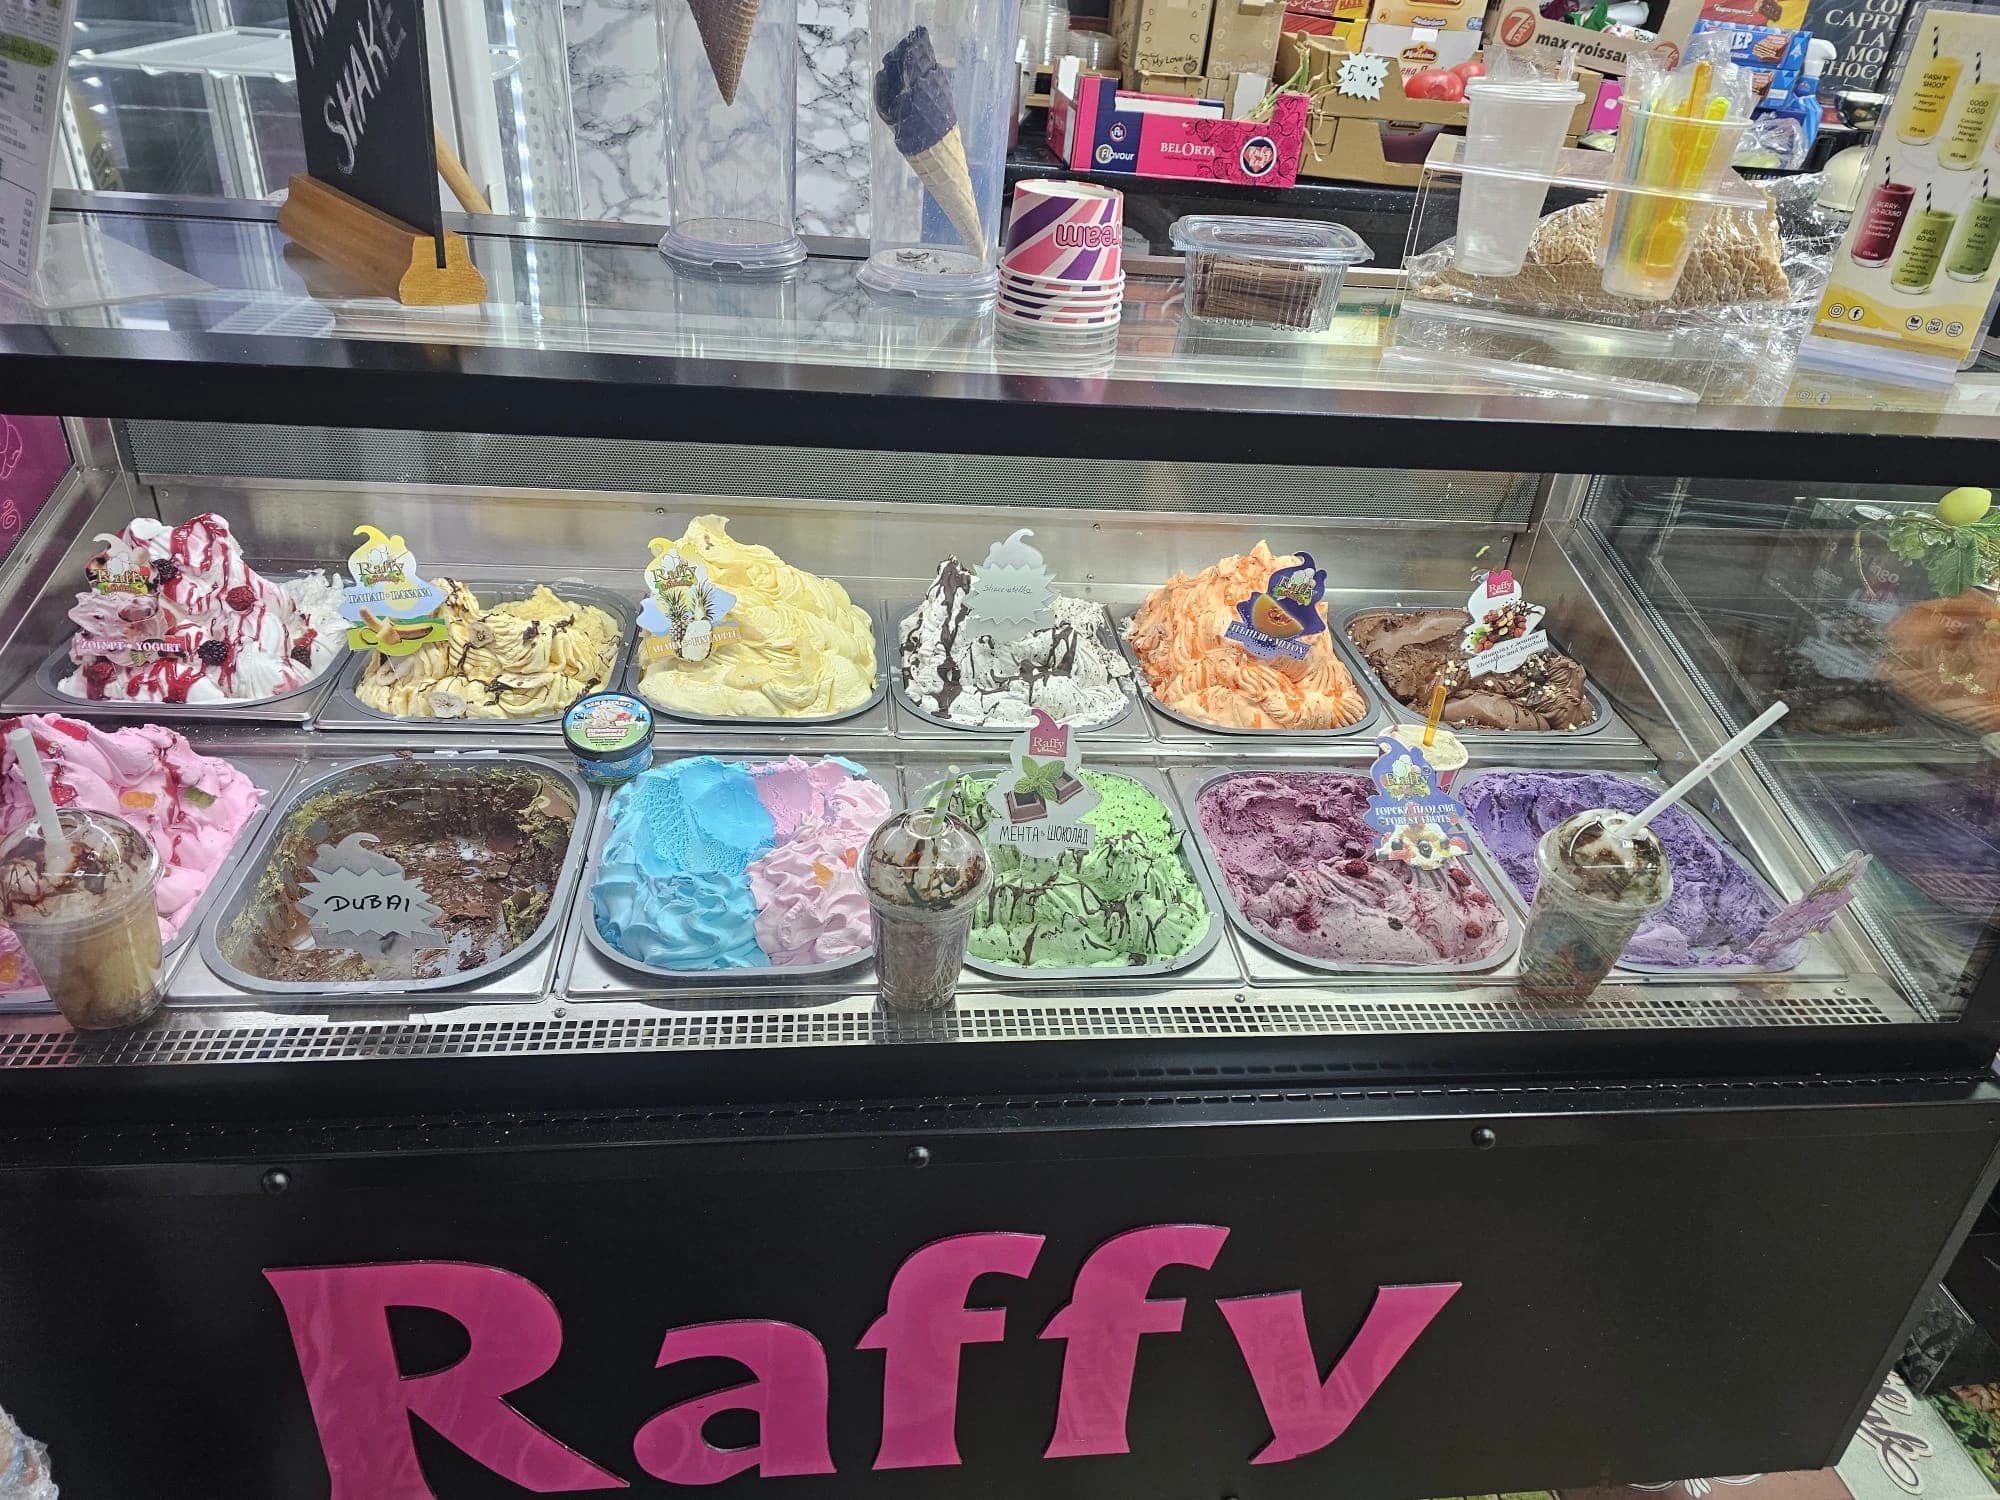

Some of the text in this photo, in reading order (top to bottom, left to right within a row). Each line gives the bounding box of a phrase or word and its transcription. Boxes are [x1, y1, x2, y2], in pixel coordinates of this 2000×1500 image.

[1536, 33, 1567, 49] max
[323, 0, 407, 175] SHAKE
[1101, 149, 1136, 160] Flavour
[1160, 141, 1216, 157] BELORTA
[1056, 223, 1120, 247] ream
[356, 559, 404, 576] Raffy
[651, 565, 697, 582] Raffy
[95, 568, 149, 584] Raffy
[1279, 576, 1315, 602] Raffy
[1488, 581, 1513, 593] Raffy
[136, 642, 181, 652] YOGURT
[1507, 647, 1519, 657] and
[1032, 737, 1065, 751] Raffy
[999, 823, 1089, 846] МЕНТА ШОКОЛАД
[324, 894, 410, 912] DUBAI
[262, 1223, 1462, 1500] Raffy
